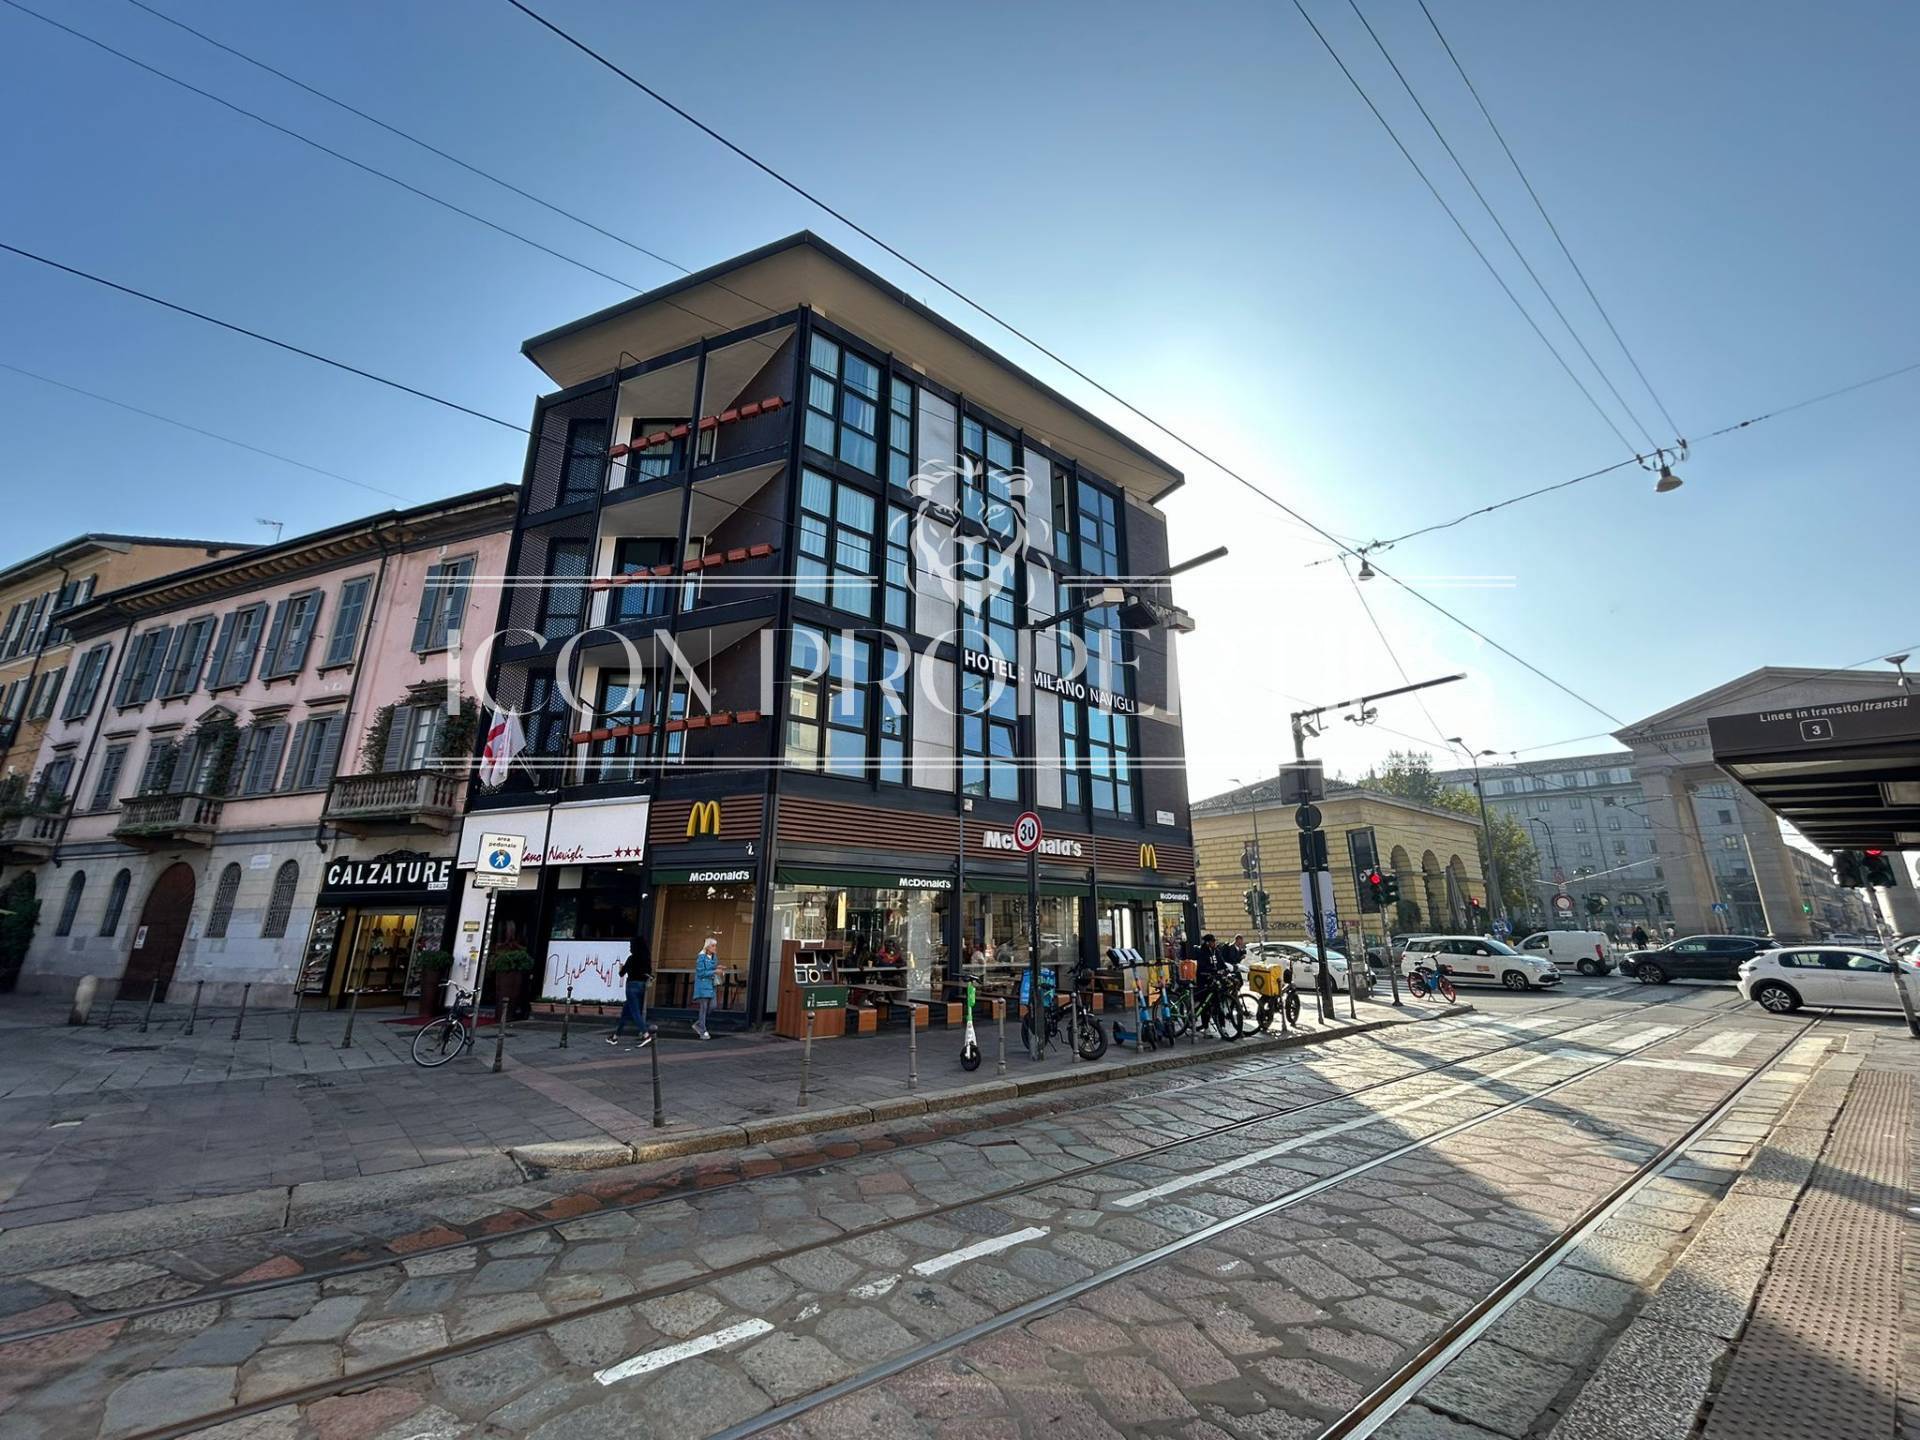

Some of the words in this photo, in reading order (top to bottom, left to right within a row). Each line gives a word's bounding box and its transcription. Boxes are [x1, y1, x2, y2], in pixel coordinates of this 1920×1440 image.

[964, 649, 1017, 680] HOTEL
[1034, 671, 1085, 699] MILANO
[1089, 687, 1135, 713] NAVIGLI
[1759, 712, 1793, 722] Linee
[1796, 709, 1808, 718] in
[1811, 725, 1821, 735] 3
[1020, 823, 1036, 841] 30
[983, 830, 1082, 857] Mcnald's
[549, 845, 584, 862] Navigli
[327, 860, 452, 885] CALZATURE
[689, 870, 750, 882] McDonald's
[899, 877, 951, 889] McDonald's
